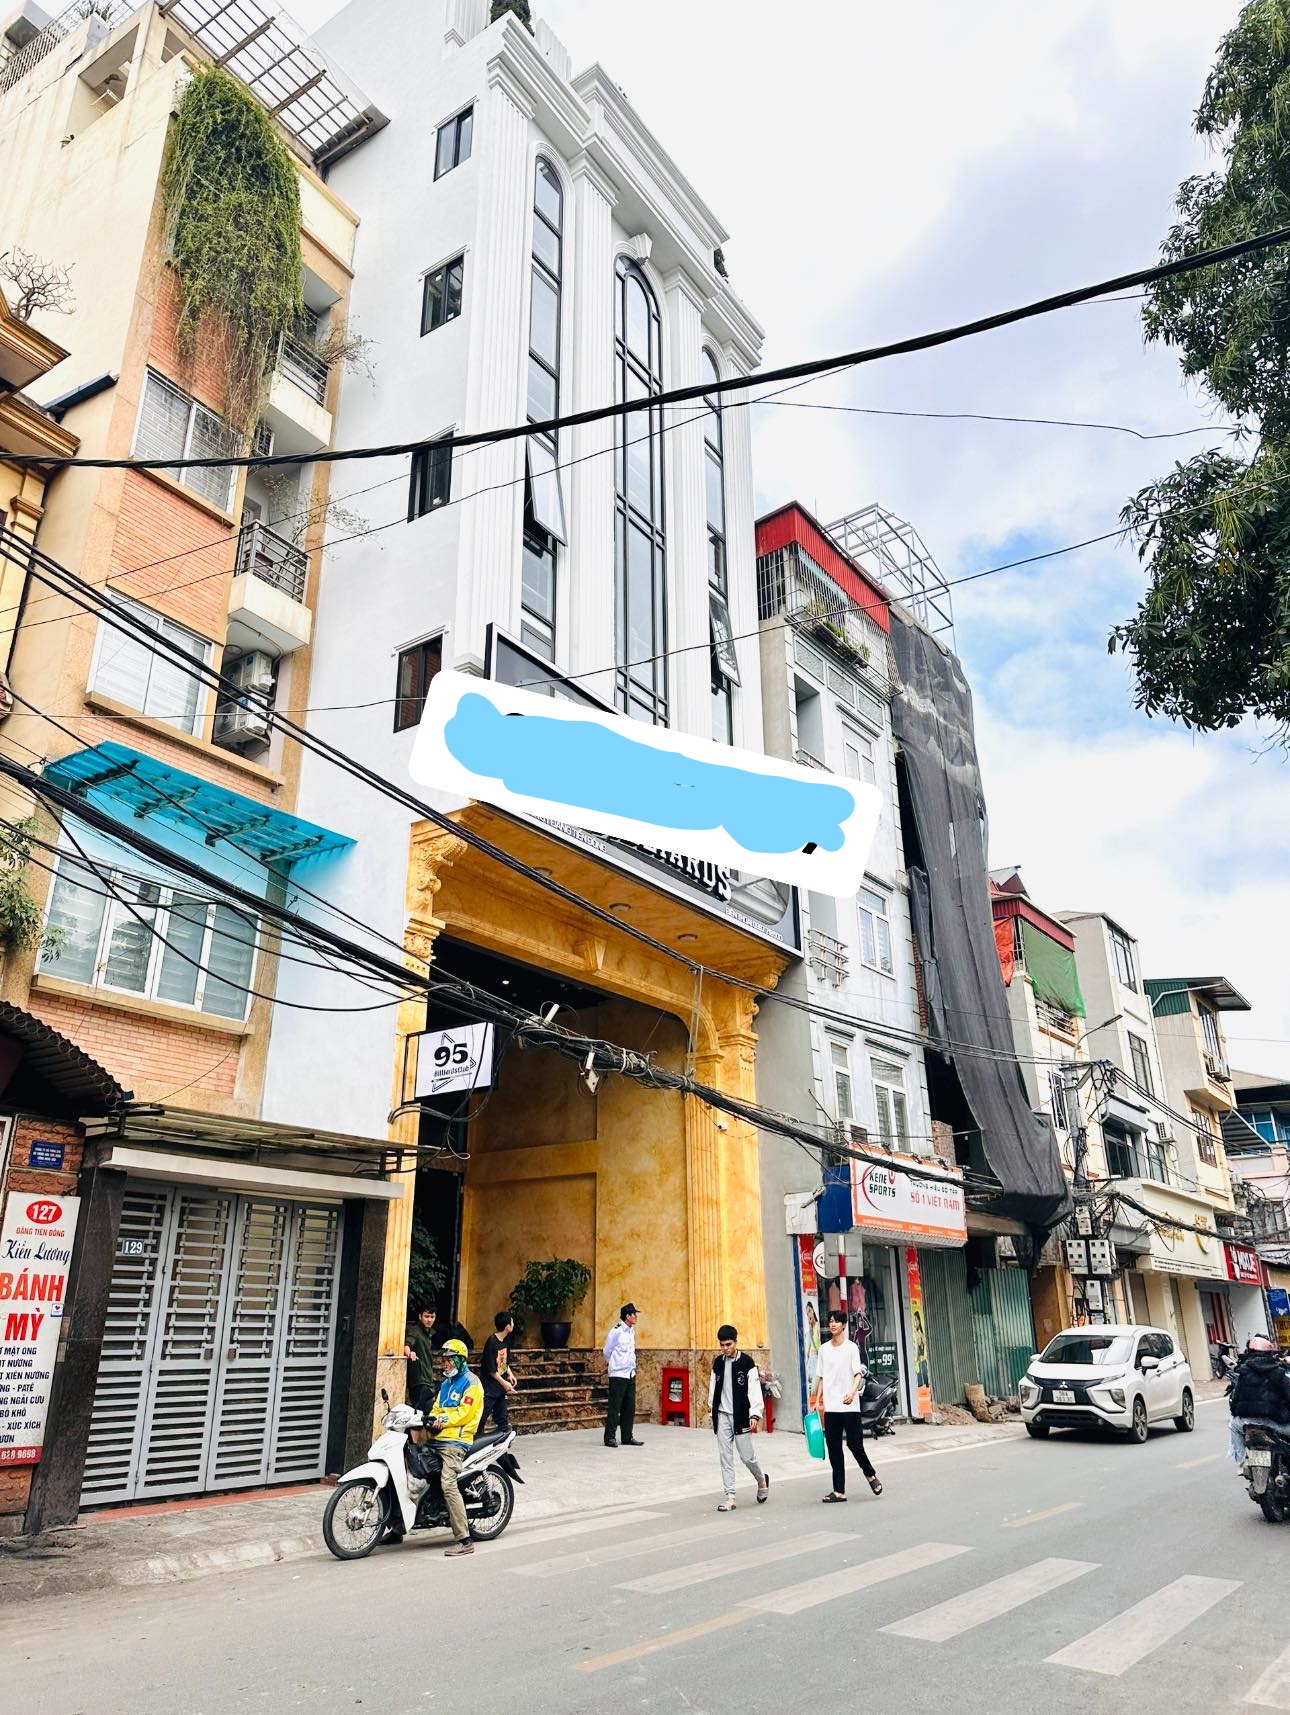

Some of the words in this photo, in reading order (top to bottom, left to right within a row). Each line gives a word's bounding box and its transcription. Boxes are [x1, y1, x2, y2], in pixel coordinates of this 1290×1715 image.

[434, 1043, 468, 1067] 95
[869, 1184, 896, 1198] SPORTS
[32, 1204, 58, 1221] 127
[34, 1241, 71, 1266] Lương
[124, 1241, 143, 1254] 129
[0, 1267, 65, 1302] BÁNH
[21, 1347, 37, 1355] ONG
